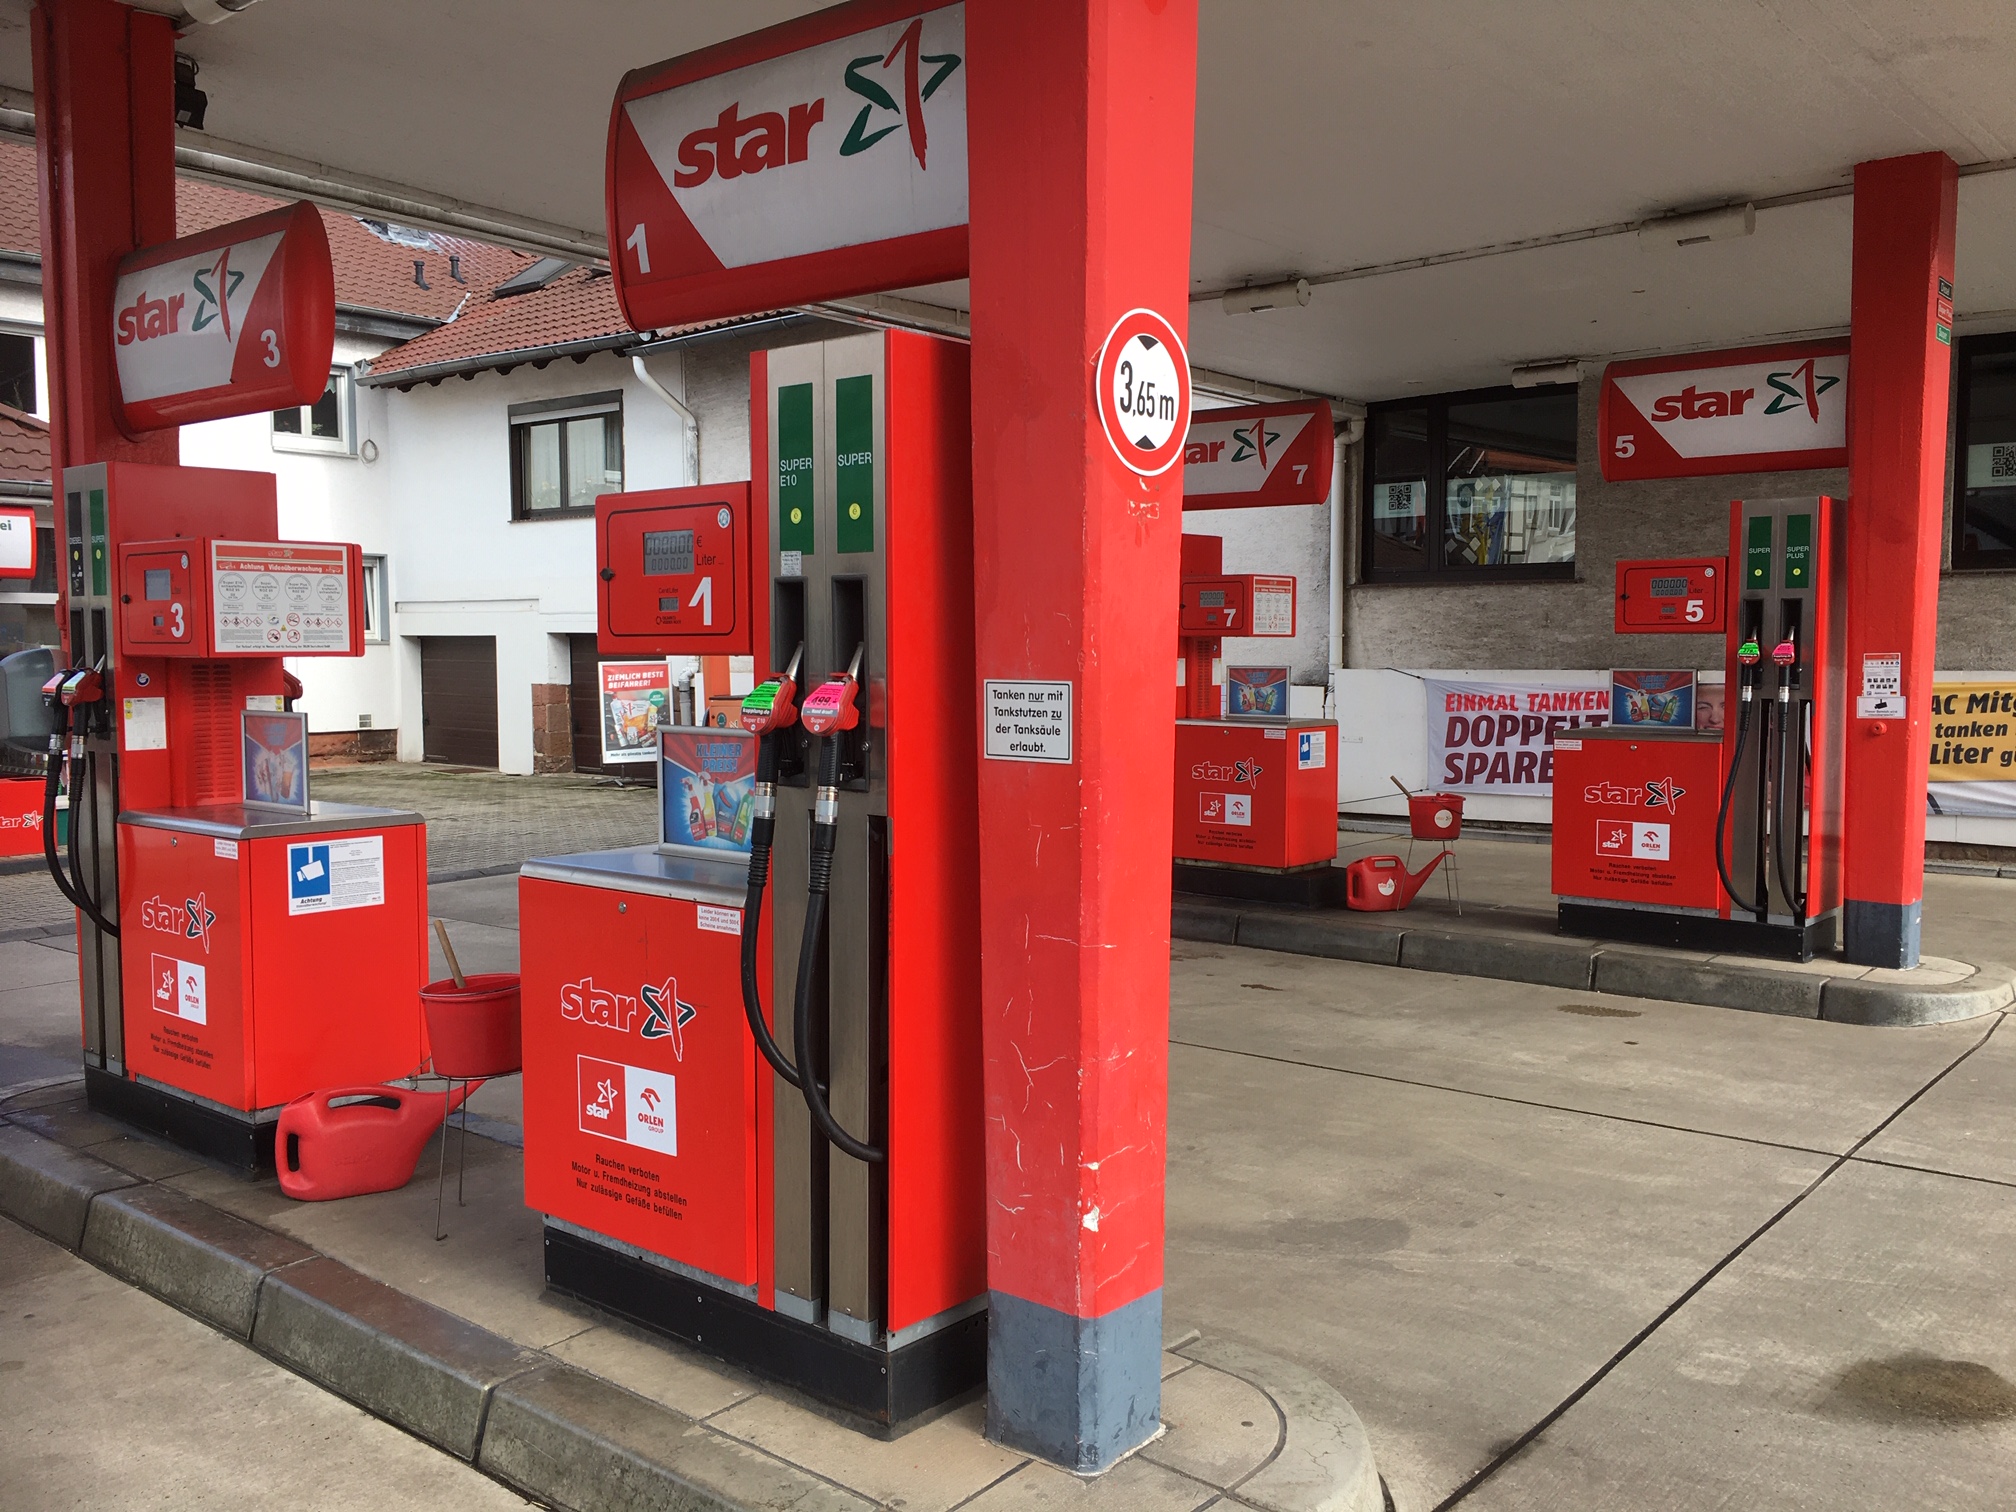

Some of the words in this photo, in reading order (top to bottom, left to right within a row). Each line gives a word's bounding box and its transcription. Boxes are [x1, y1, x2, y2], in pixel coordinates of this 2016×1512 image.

[673, 97, 825, 189] star
[626, 223, 651, 274] 1
[117, 290, 185, 346] star
[260, 329, 281, 369] 3
[1119, 360, 1156, 418] 3,65
[1159, 394, 1174, 422] m
[1651, 385, 1755, 422] star
[1614, 435, 1636, 458] 5
[780, 457, 813, 472] SUPER
[837, 451, 873, 467] SUPER
[780, 475, 797, 487] E10
[1292, 464, 1309, 485] 7
[69, 537, 82, 545] DIESEL
[91, 535, 105, 543] SUPER
[696, 535, 703, 548] €
[696, 554, 716, 566] Liter
[240, 563, 265, 572] Achtung
[268, 564, 323, 574] Videoüberwachung
[688, 576, 712, 626] 1
[1223, 608, 1236, 627] 7
[1685, 600, 1704, 622] 5
[171, 602, 185, 638] 3
[607, 672, 641, 681] ZIEMLICH
[642, 671, 664, 679] BESTE
[608, 680, 650, 689] BEIFAHRER!
[992, 689, 1025, 700] Tanken
[1028, 692, 1044, 701] nur
[1047, 690, 1063, 701] mit
[1445, 692, 1520, 713] EINMAL
[1527, 690, 1609, 712] TANKEN
[743, 716, 756, 724] Super
[993, 706, 1048, 718] Tankstutzen
[1051, 710, 1062, 719] zu
[995, 723, 1011, 734] der
[1013, 724, 1061, 736] Tanksäule
[1935, 721, 2008, 738] tanken
[696, 743, 742, 757] KLEINER
[1009, 741, 1046, 752] erlaubt.
[1930, 741, 1994, 765] Liter
[702, 758, 737, 773] PREIS!
[1191, 760, 1233, 782] star
[1584, 781, 1643, 806] star
[1602, 841, 1620, 849] star
[300, 897, 323, 905] Achtung
[142, 895, 184, 935] star
[156, 987, 171, 1000] star
[185, 994, 199, 1005] ORLEN
[560, 977, 637, 1033] star
[586, 1102, 610, 1120] star
[637, 1112, 664, 1128] ORLEN
[648, 1125, 664, 1134] GROUP
[595, 1153, 625, 1171] Rauchen
[628, 1165, 660, 1182] verboten
[572, 1160, 591, 1175] Motor
[594, 1170, 600, 1179] u.
[602, 1170, 651, 1197] Fremdheizung
[654, 1188, 687, 1206] abstellen
[576, 1177, 587, 1189] Nur
[590, 1183, 622, 1201] zulässige
[625, 1193, 650, 1210] Gefäße
[653, 1202, 683, 1220] befüllen
